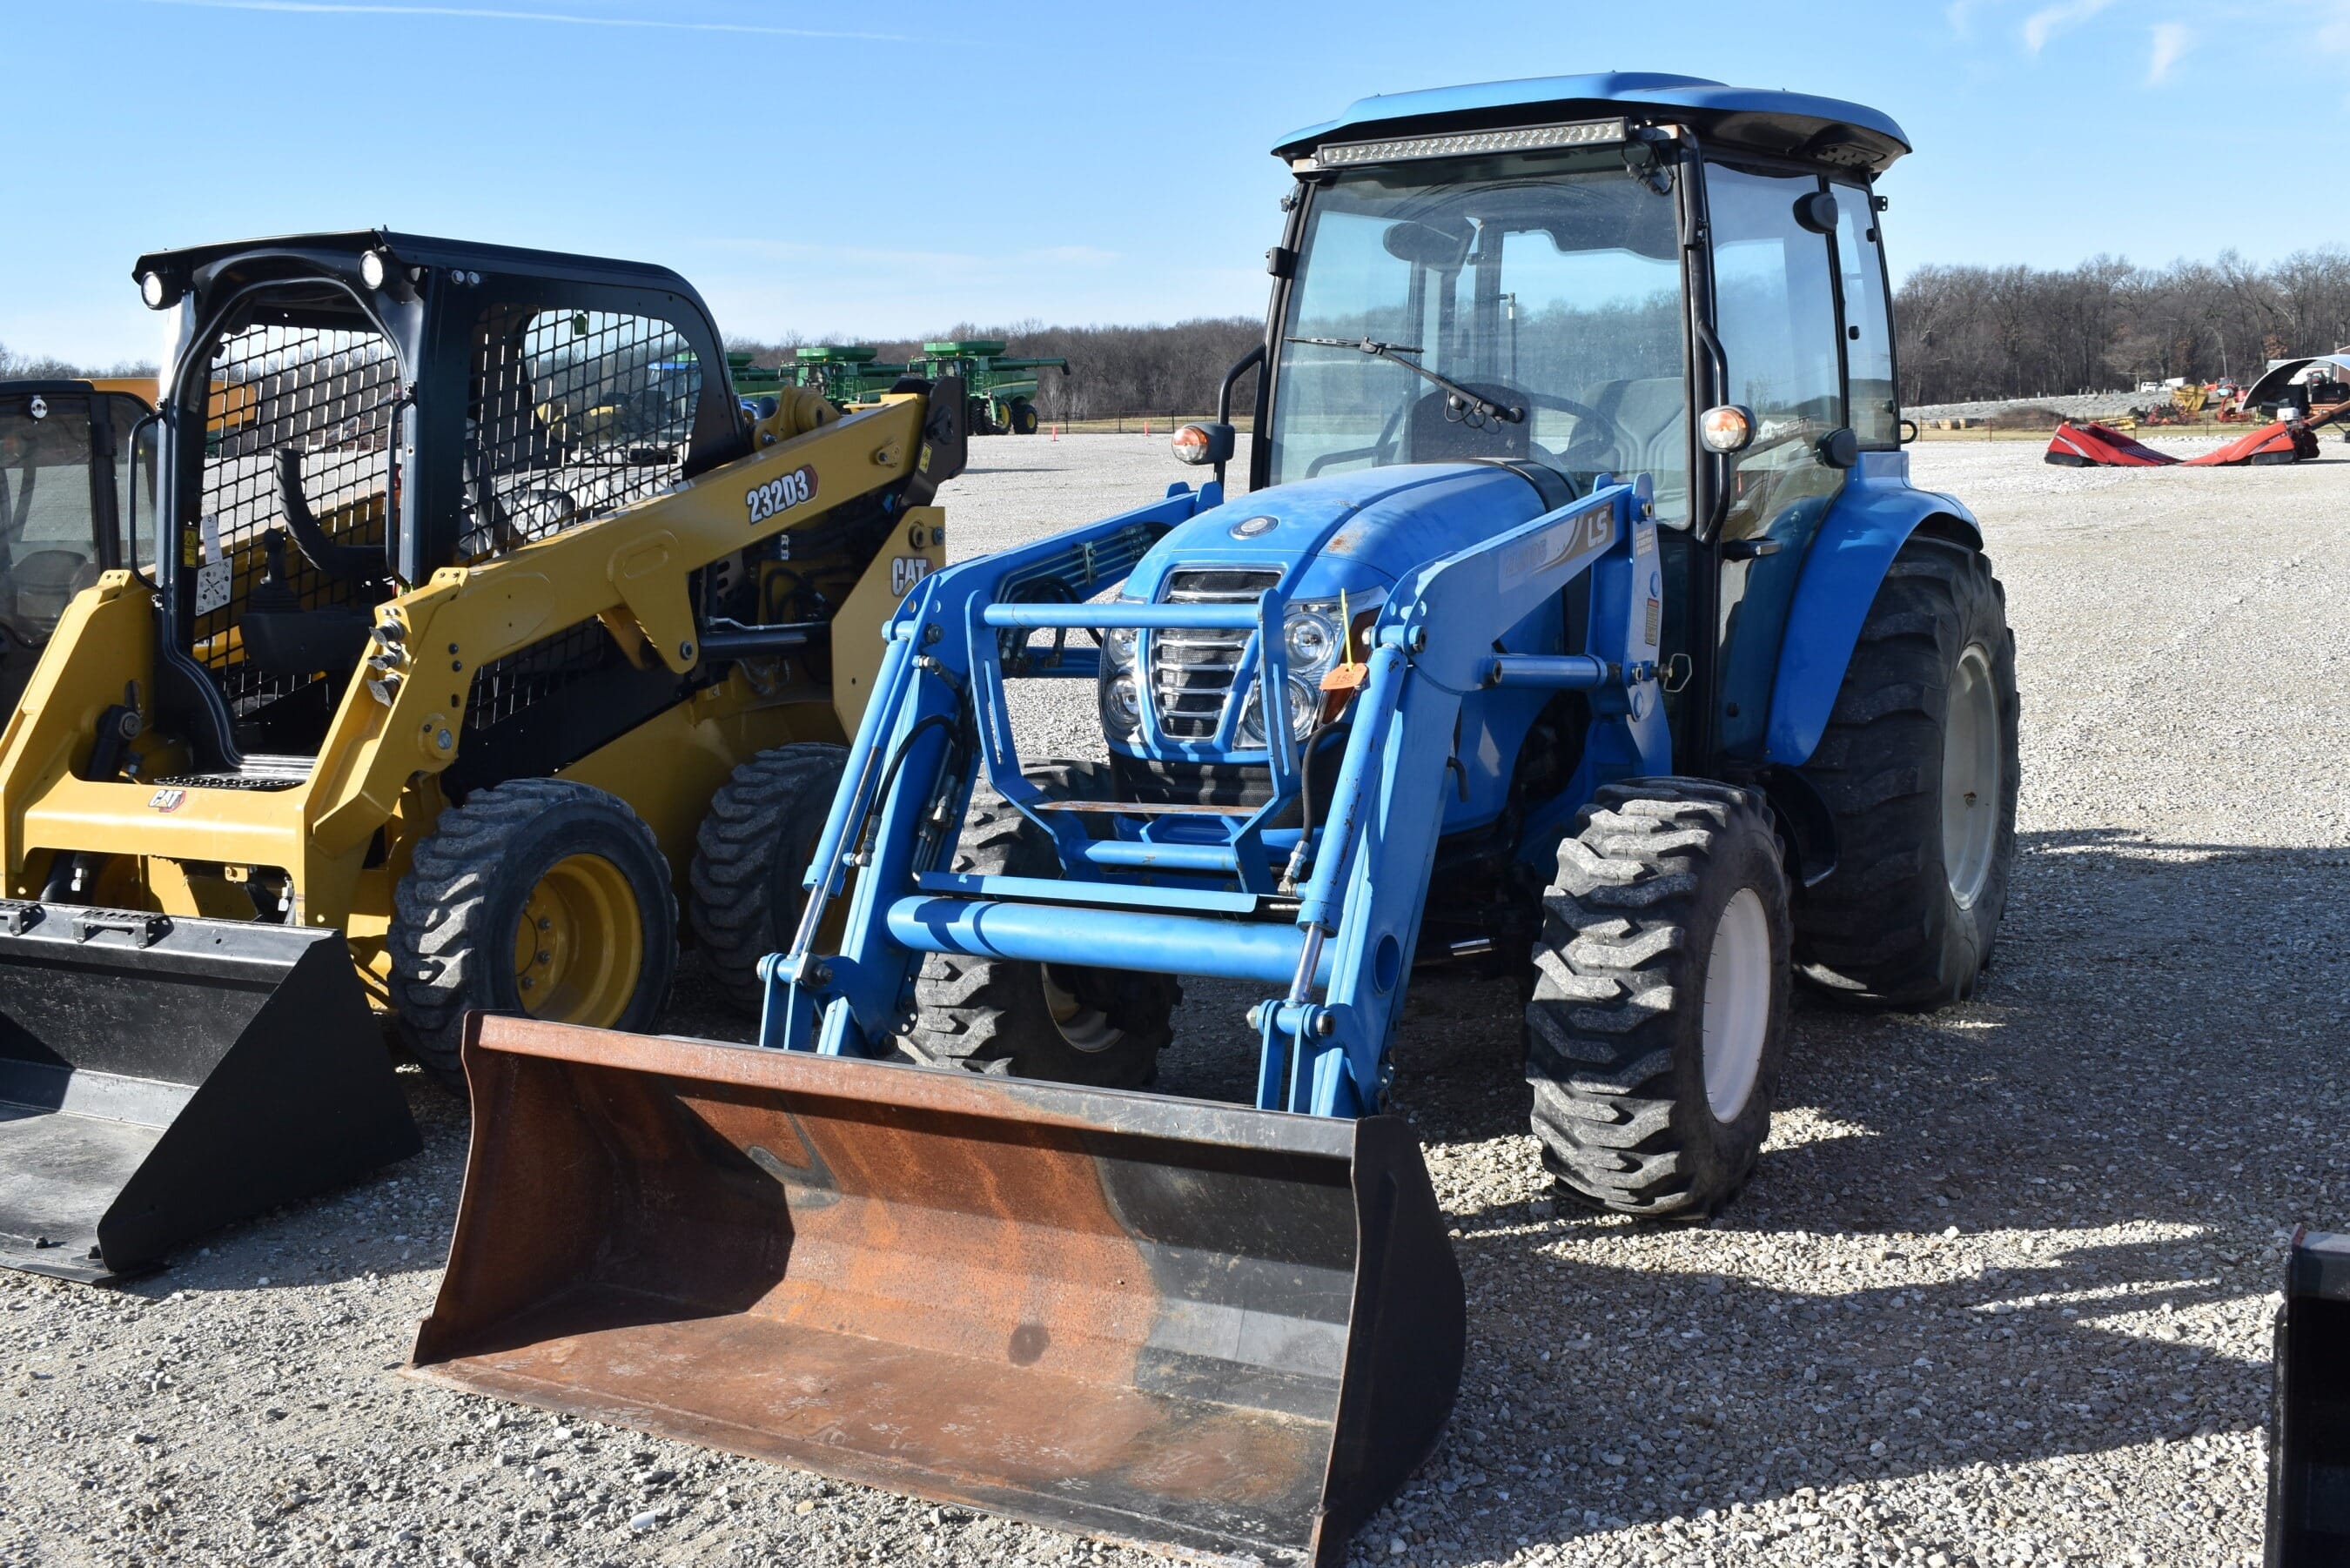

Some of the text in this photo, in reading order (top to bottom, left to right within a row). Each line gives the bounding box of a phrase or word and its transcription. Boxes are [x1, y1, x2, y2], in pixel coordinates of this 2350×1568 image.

[747, 469, 809, 524] 232D3
[1587, 510, 1608, 548] LS
[892, 557, 927, 595] CAT
[149, 788, 184, 807] CAT
